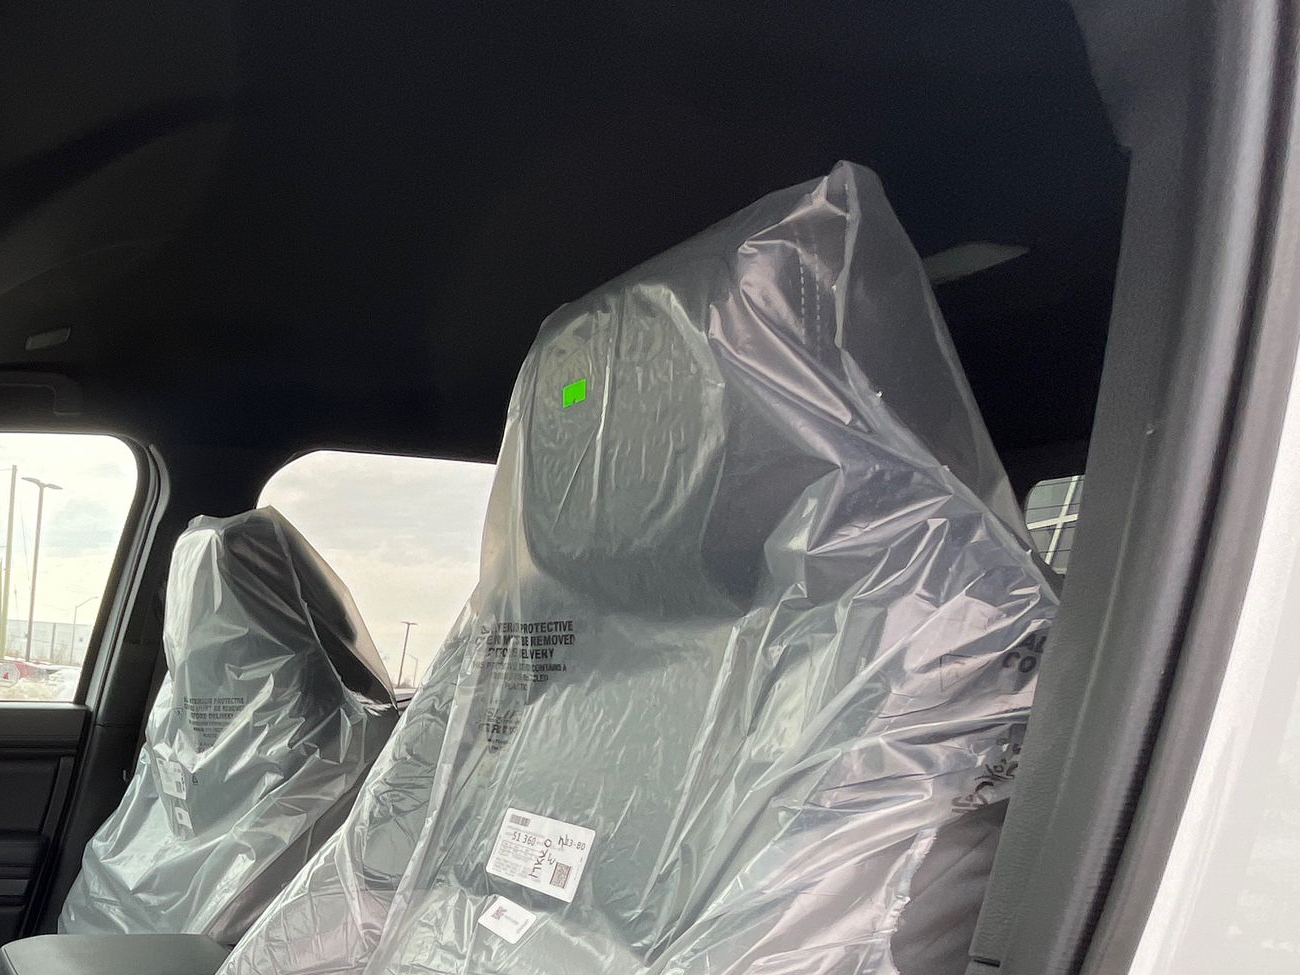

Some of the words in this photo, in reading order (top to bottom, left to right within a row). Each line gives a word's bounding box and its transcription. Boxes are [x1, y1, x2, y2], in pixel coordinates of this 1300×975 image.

[520, 620, 574, 633] PROTECTIVE
[530, 634, 576, 646] REMOVED
[1017, 634, 1047, 653] AL
[1003, 652, 1036, 672] CO
